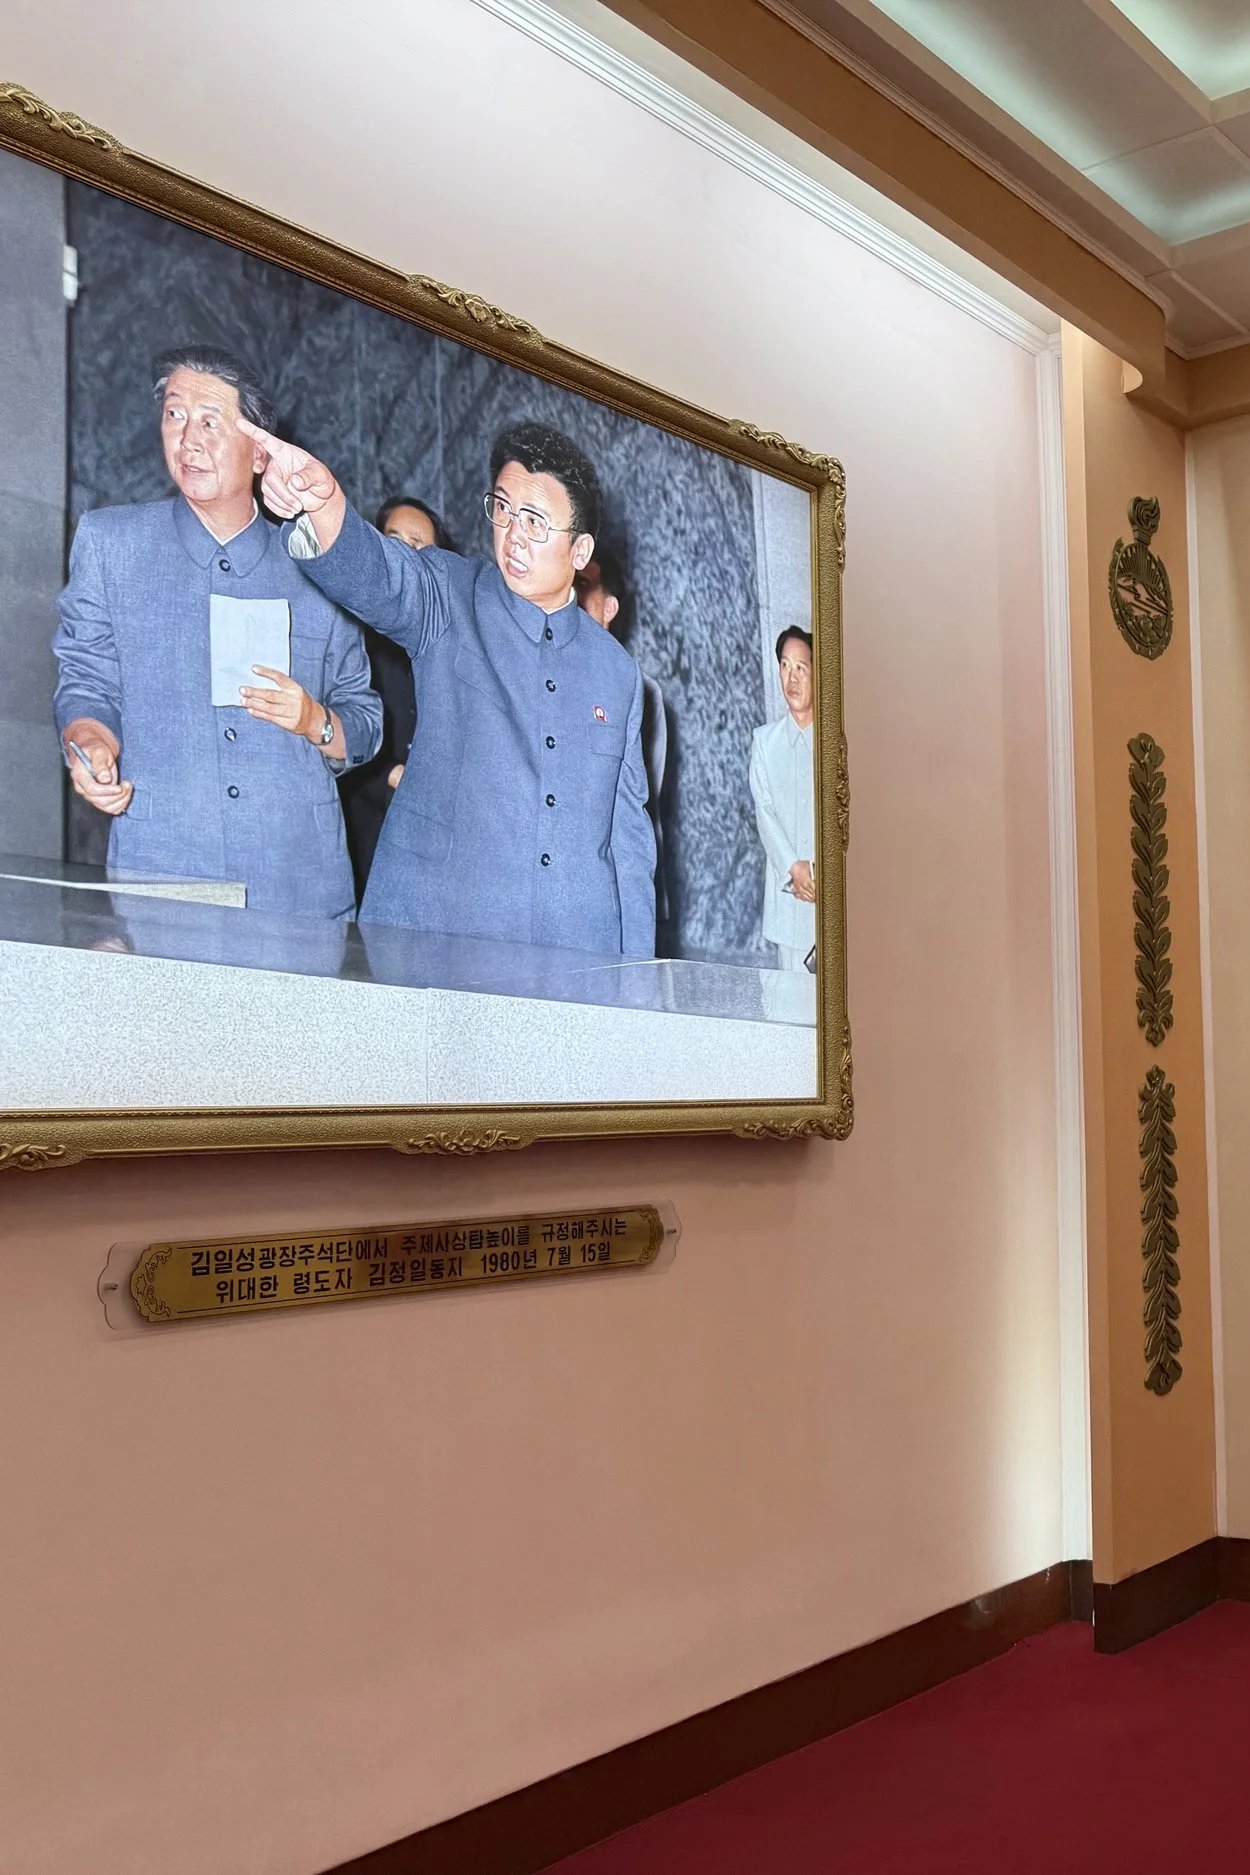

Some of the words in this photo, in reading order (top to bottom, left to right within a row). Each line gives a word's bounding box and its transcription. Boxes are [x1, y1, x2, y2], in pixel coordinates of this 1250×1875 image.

[190, 1237, 389, 1277] 김일성광장주석단에서
[541, 1217, 627, 1243] 규정해주시는
[215, 1274, 279, 1304] 위대한
[293, 1267, 353, 1295] 령도자
[368, 1256, 463, 1287] 김정일동지
[480, 1248, 537, 1275] 1980년
[547, 1245, 571, 1267] 7월
[580, 1241, 611, 1264] 15일
